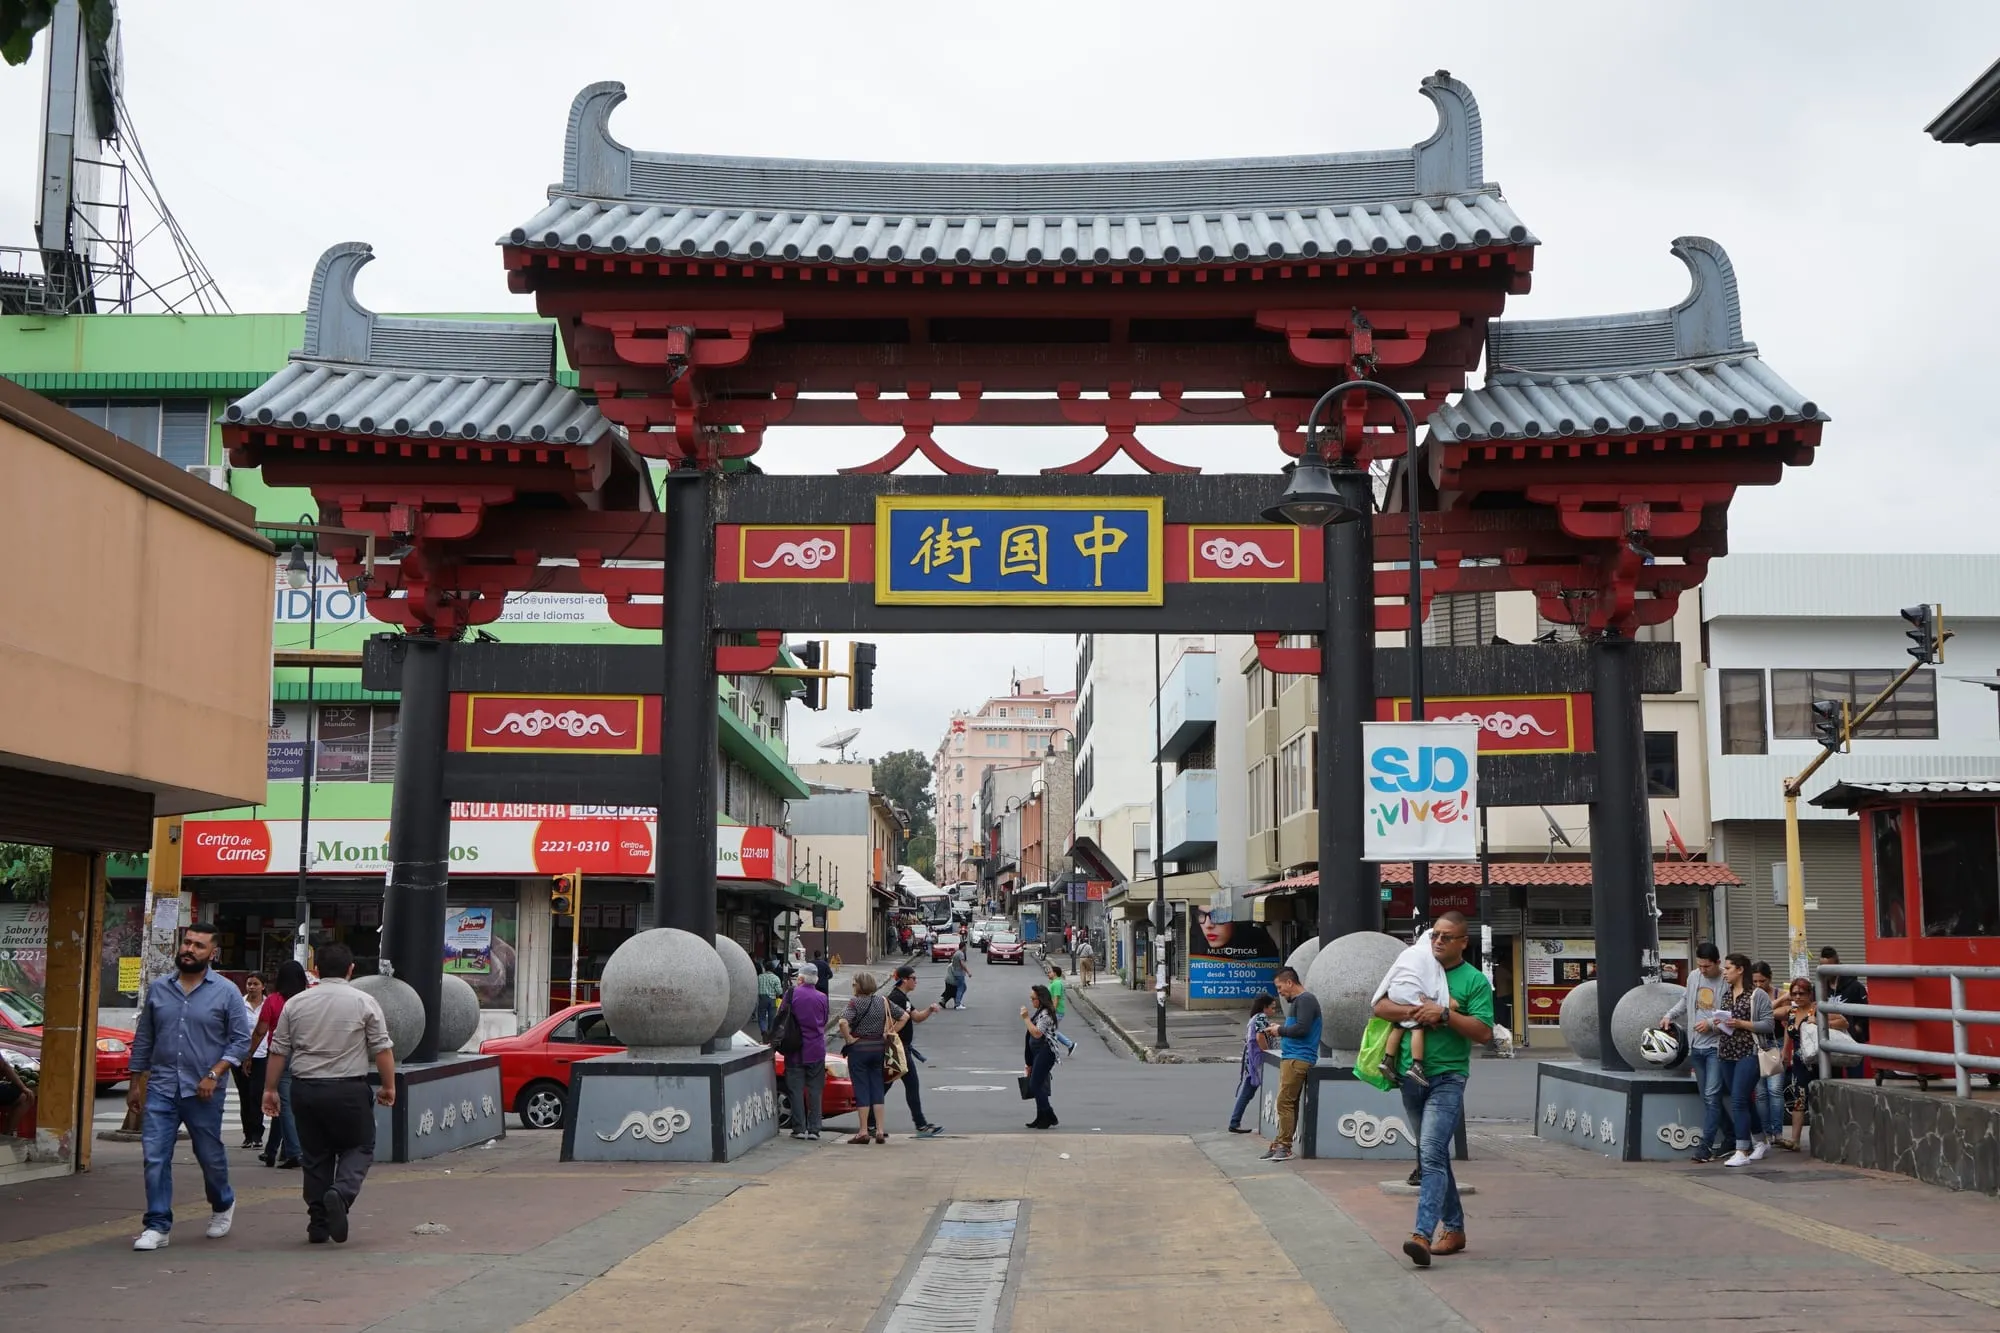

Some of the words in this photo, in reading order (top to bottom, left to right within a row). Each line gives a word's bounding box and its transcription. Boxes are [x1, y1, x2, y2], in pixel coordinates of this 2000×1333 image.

[526, 610, 540, 620] de
[543, 610, 585, 620] Idiomas
[325, 707, 356, 721] 中文
[1369, 746, 1469, 793] SJO
[502, 803, 566, 818] ABIERTA
[196, 832, 240, 846] Centro
[240, 836, 252, 846] de
[540, 841, 610, 852] 2221-0310
[621, 841, 639, 849] Centro
[216, 846, 267, 861] Carnes
[742, 848, 769, 858] 2221-0310
[5, 925, 32, 934] Sabor
[33, 928, 40, 936] y
[2, 935, 34, 944] directo
[1228, 970, 1257, 978] 15000
[1202, 986, 1216, 994] Tel
[1218, 986, 1268, 994] 2221-4926
